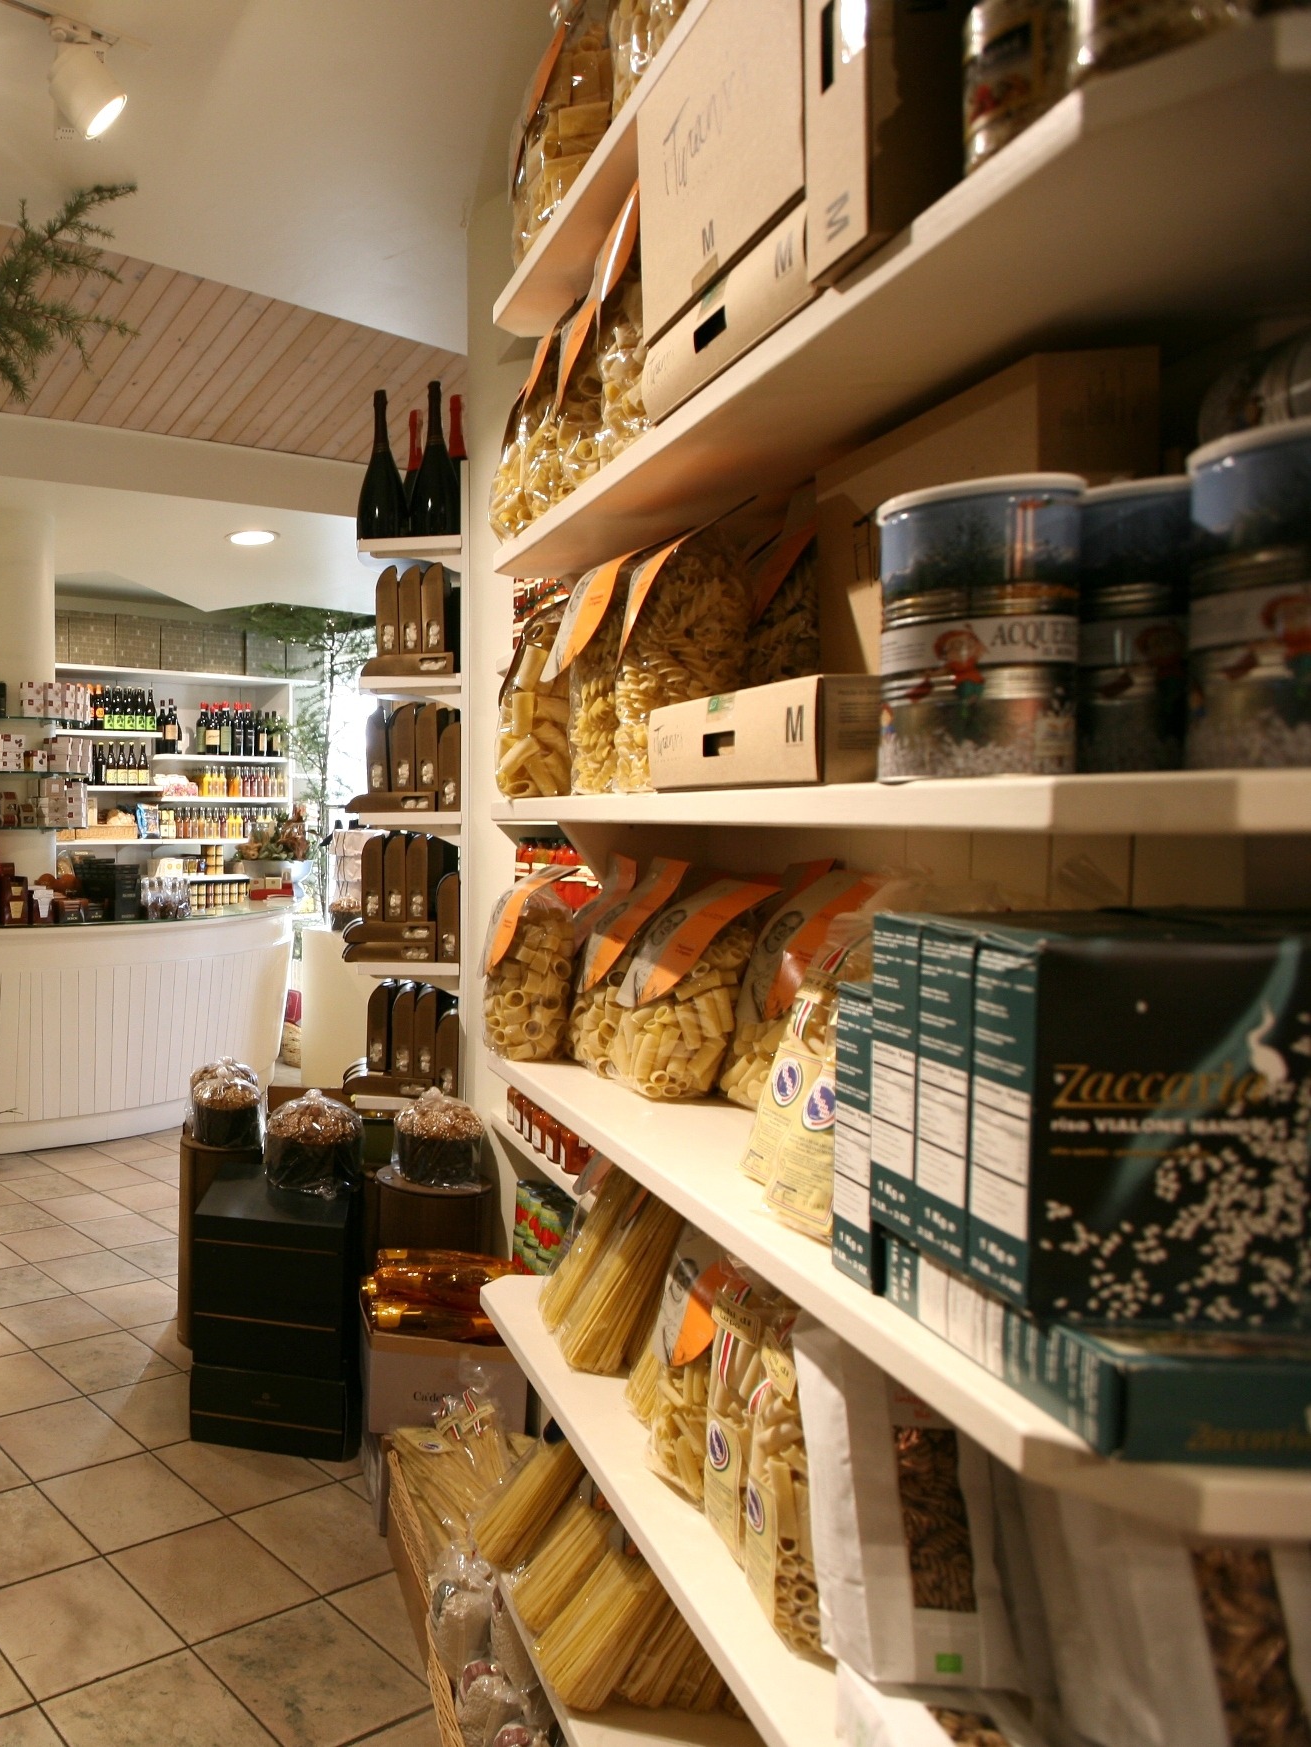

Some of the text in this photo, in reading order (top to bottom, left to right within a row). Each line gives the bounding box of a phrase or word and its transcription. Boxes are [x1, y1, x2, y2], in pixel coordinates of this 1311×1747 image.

[702, 219, 715, 256] M
[775, 231, 793, 279] M
[785, 705, 804, 743] M
[1052, 1061, 1268, 1110] Zaccaria
[1093, 1117, 1186, 1134] VIALONE
